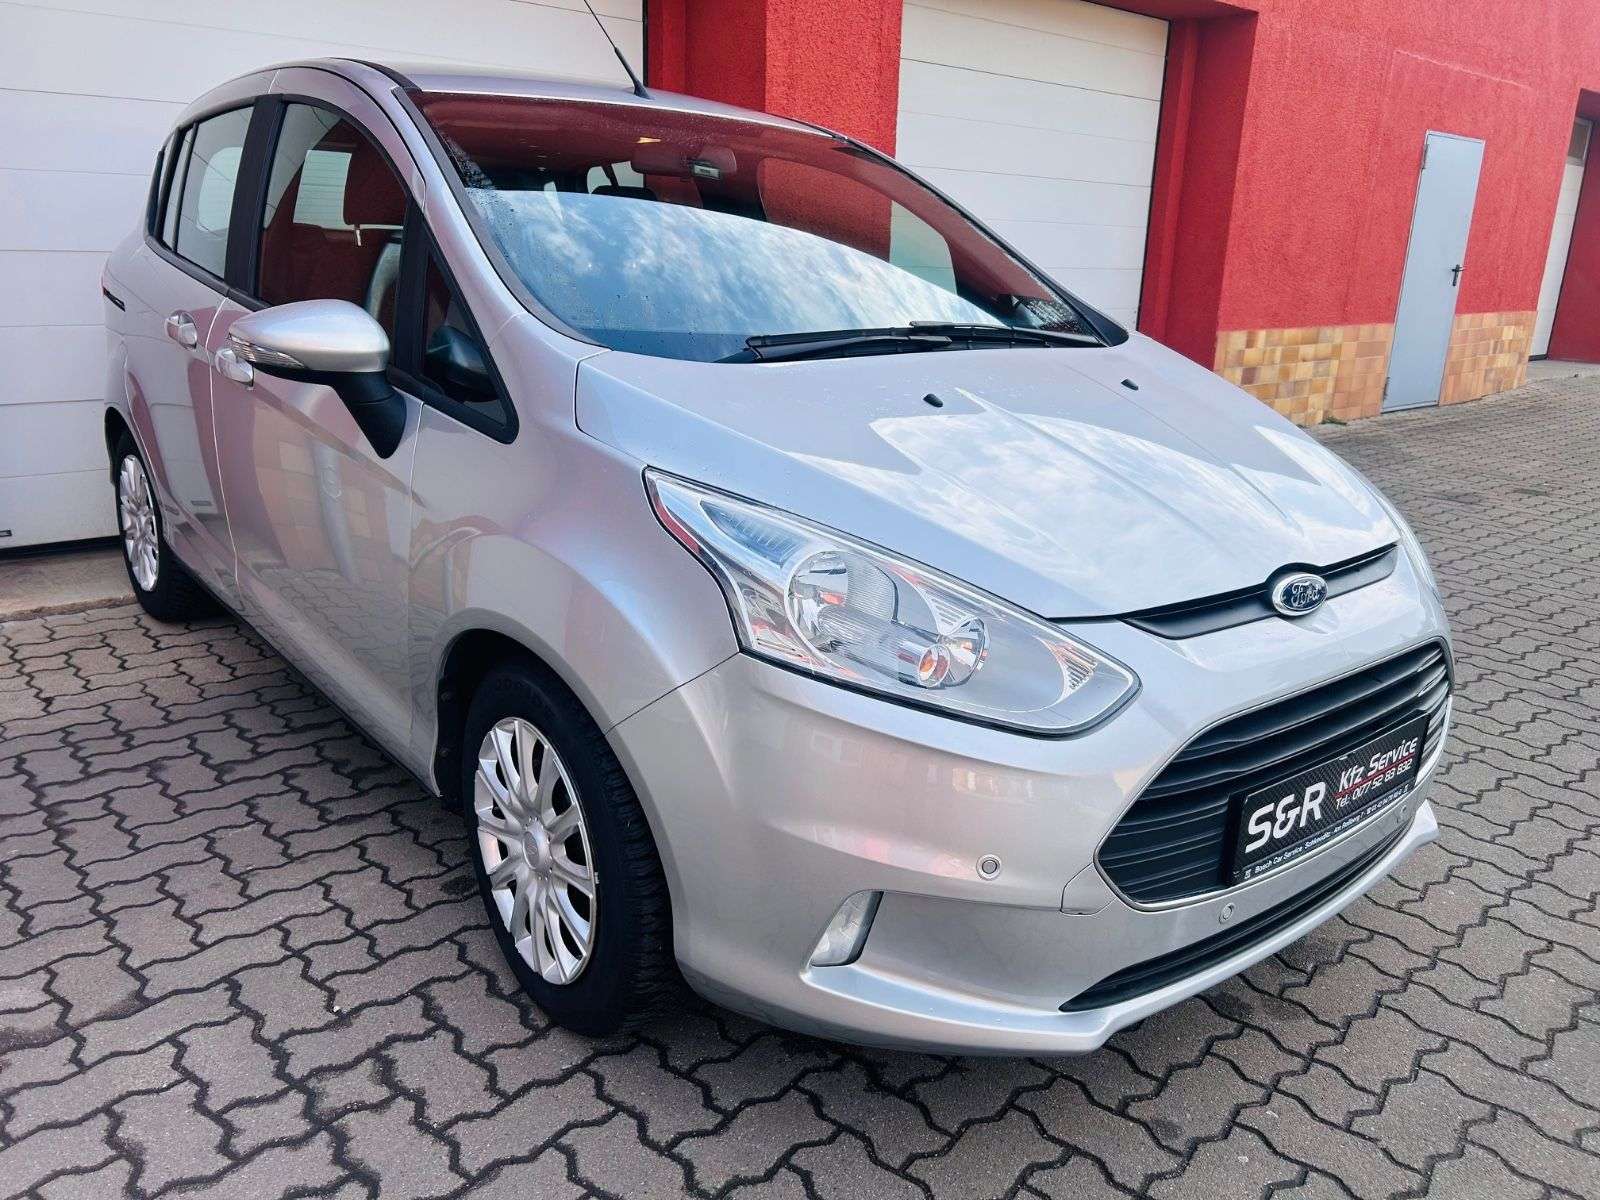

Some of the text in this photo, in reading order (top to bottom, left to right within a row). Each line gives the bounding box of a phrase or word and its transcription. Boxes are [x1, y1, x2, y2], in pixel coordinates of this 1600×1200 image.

[1290, 580, 1322, 608] Ford
[1339, 737, 1418, 792] Kfz Service
[1244, 781, 1326, 853] S&R
[1254, 860, 1273, 874] Bosch
[1283, 846, 1304, 860] Service
